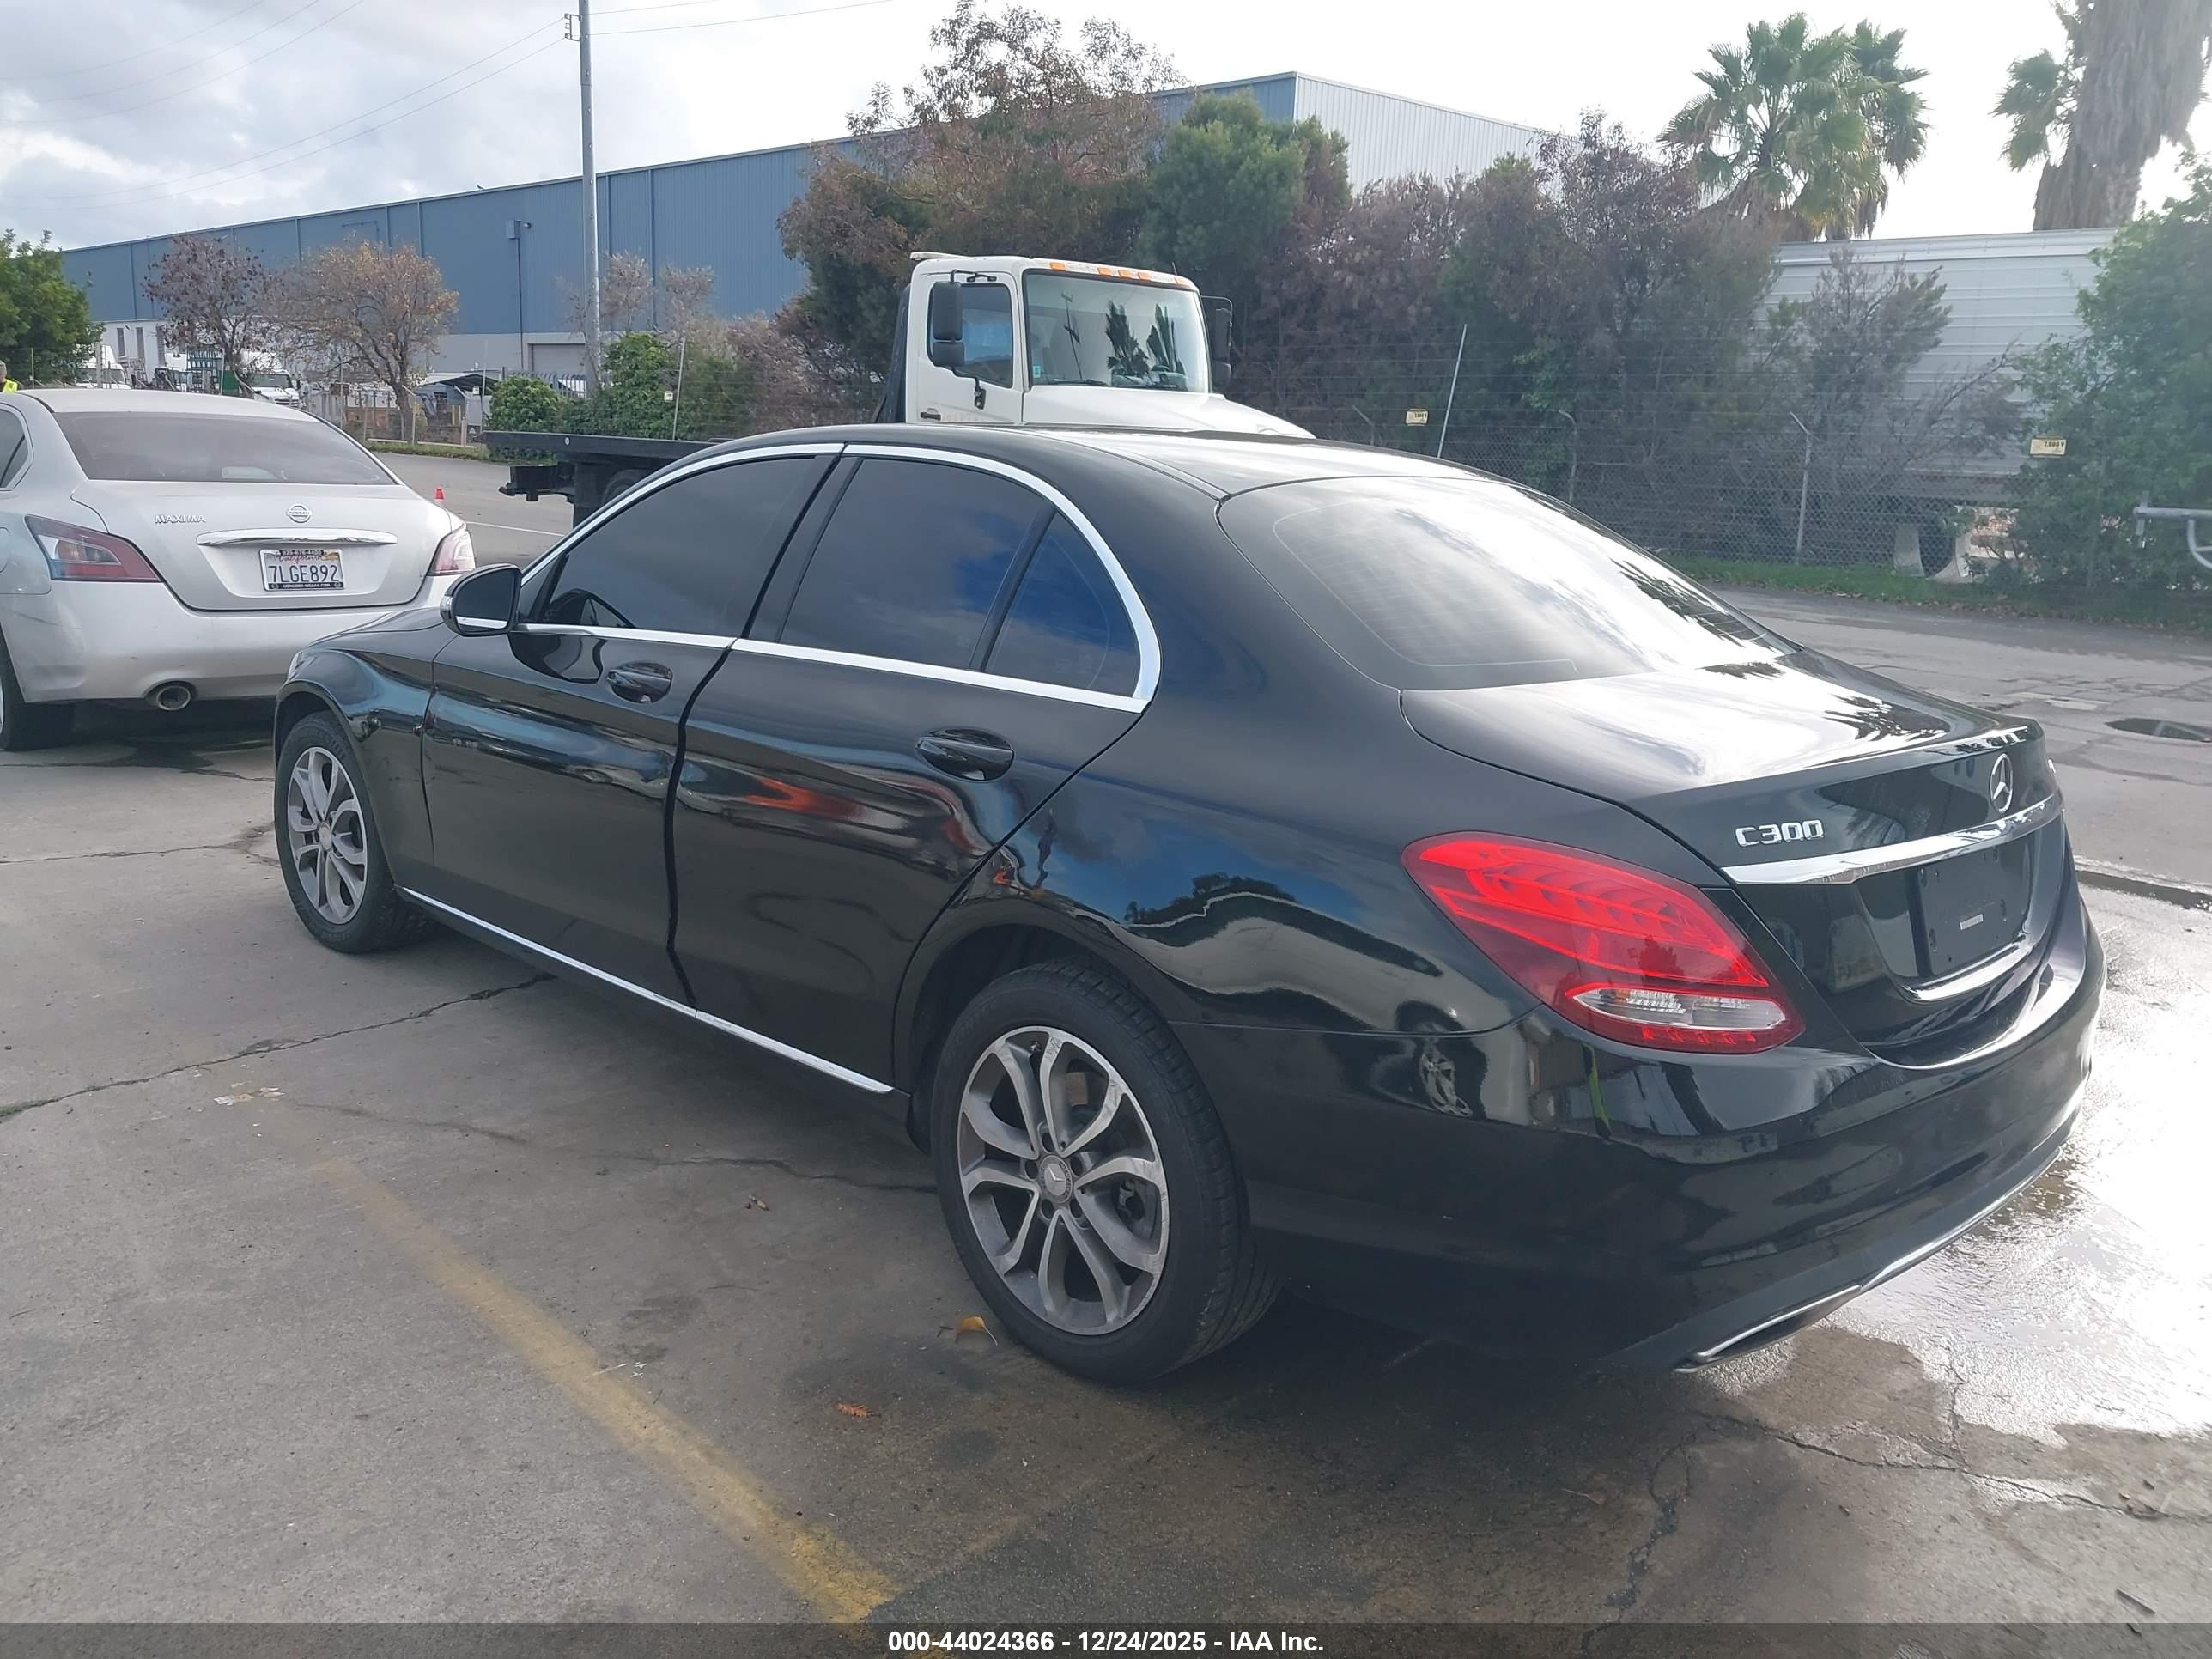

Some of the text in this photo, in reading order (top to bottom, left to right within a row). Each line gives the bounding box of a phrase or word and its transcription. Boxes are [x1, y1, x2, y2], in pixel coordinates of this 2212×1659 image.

[155, 514, 207, 524] MAXIMA
[268, 565, 340, 582] 7LGE892
[1735, 819, 1824, 847] C300
